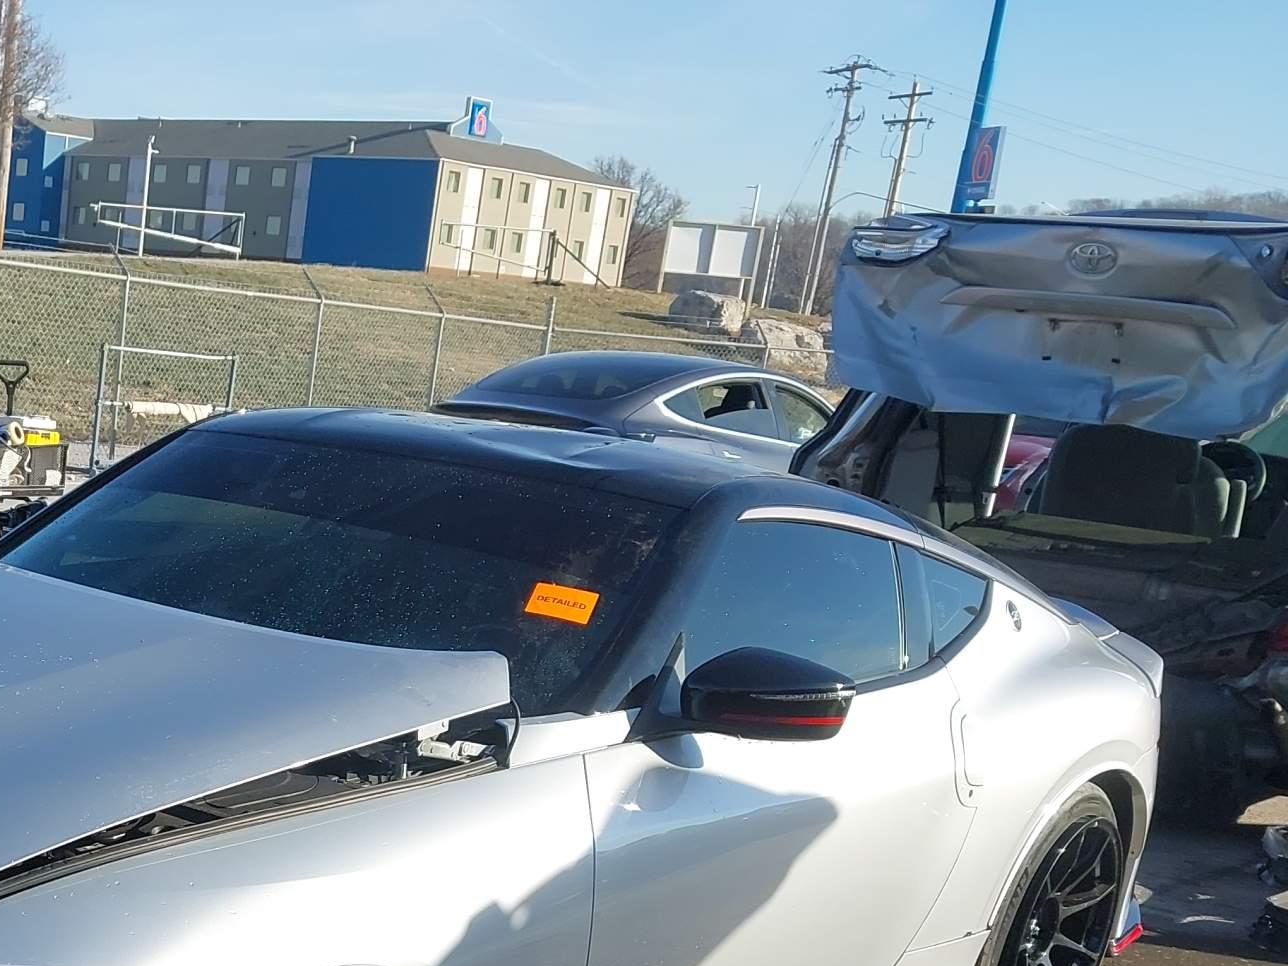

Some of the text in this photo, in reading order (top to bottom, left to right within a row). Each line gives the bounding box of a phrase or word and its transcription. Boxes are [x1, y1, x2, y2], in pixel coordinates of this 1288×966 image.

[475, 106, 487, 136] 6
[972, 129, 993, 183] 6
[537, 595, 587, 610] DETAILED
